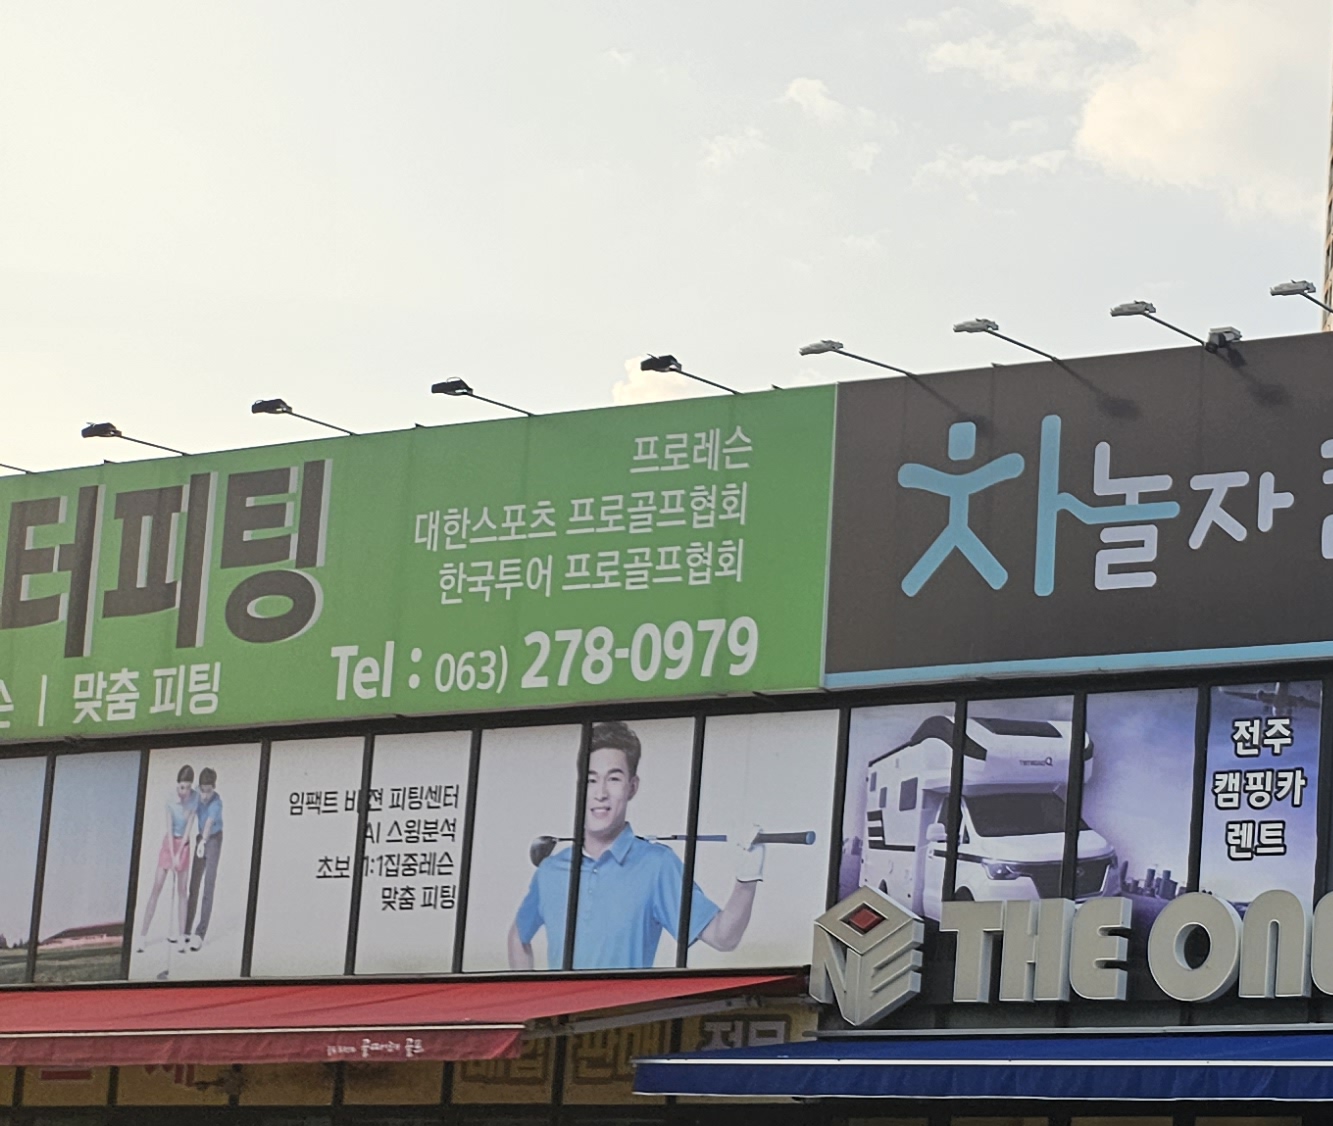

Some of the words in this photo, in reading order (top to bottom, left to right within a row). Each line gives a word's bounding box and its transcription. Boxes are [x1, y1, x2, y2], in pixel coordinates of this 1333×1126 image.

[629, 425, 753, 473] 프로레슨
[414, 500, 557, 551] 대한스포츠
[565, 481, 748, 536] 프로골프협회
[0, 458, 333, 659] 터피팅
[439, 554, 553, 605] 한국투어
[562, 538, 744, 591] 프로골프협회
[434, 645, 508, 693] 063)
[520, 615, 758, 689] 278-0979
[73, 667, 140, 724] 맞춤
[150, 662, 221, 717] 피팅
[1232, 718, 1292, 755] 전주
[289, 791, 339, 815] 임팩트
[389, 785, 459, 810] 피팅센터
[1213, 769, 1307, 808] 캠핑카
[365, 822, 381, 843] AI
[385, 818, 457, 843] 스윙분석
[1227, 822, 1285, 859] 렌트
[316, 855, 351, 878] 초보
[381, 885, 416, 911] 맞춤
[420, 885, 456, 910] 피팅
[939, 897, 1132, 1003] THE
